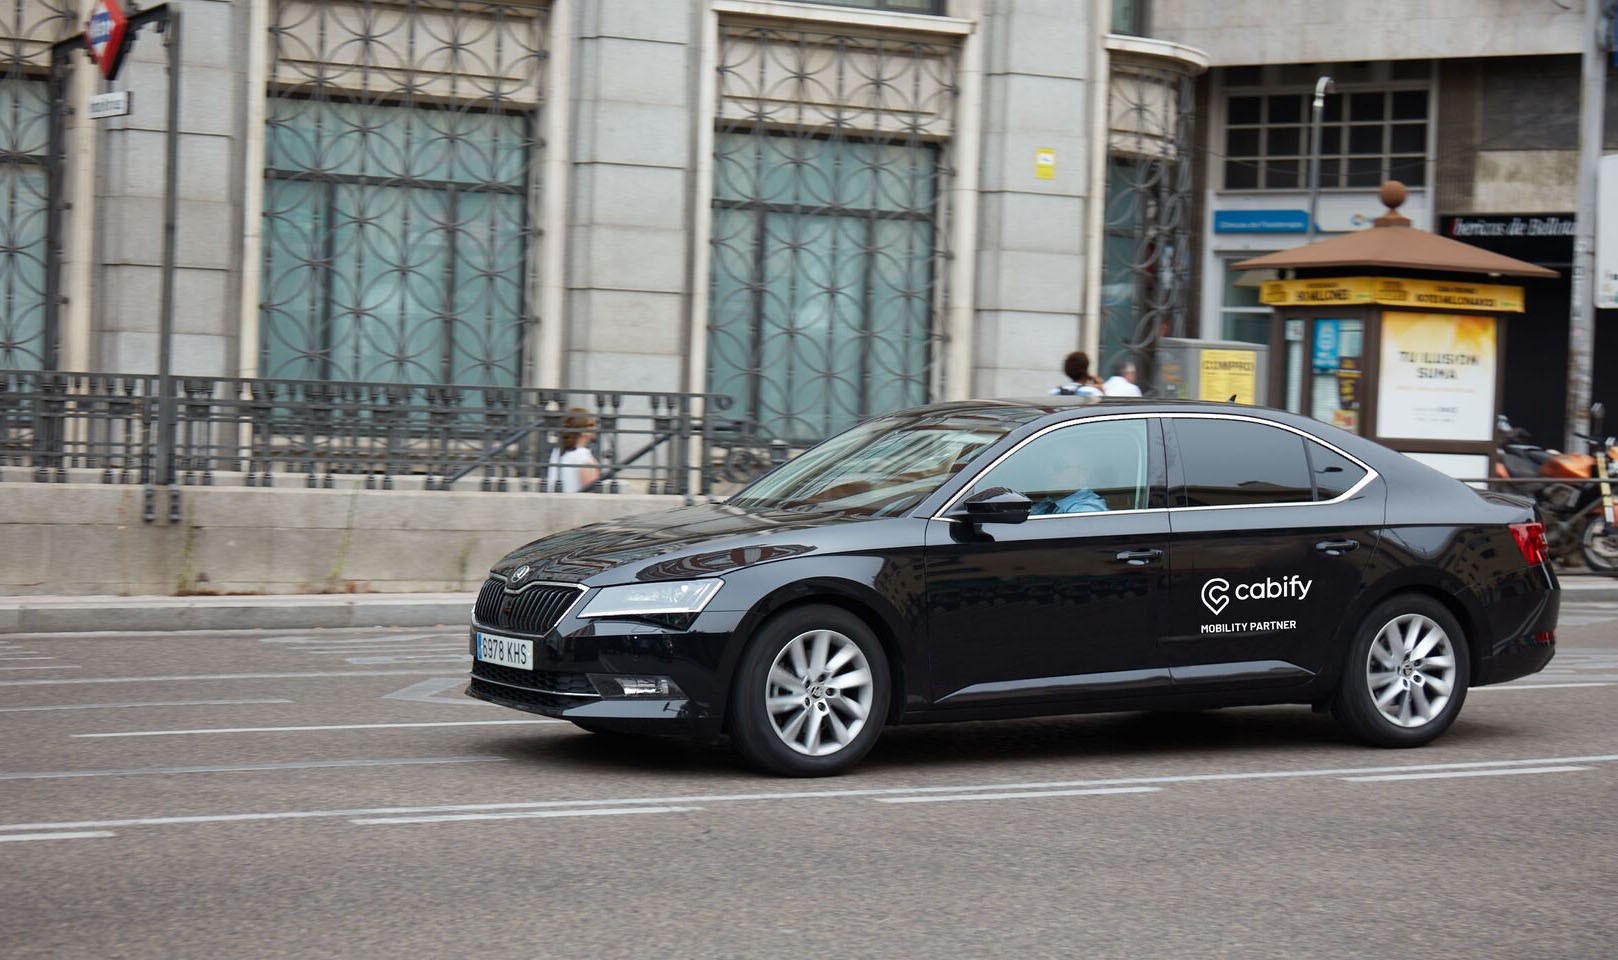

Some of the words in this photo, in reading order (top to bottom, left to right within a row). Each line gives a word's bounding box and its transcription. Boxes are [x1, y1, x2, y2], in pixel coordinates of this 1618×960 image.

[1235, 574, 1313, 600] cabify
[1200, 622, 1248, 633] MOBILITY
[1249, 620, 1297, 631] PARTNER
[482, 637, 504, 661] 6978
[507, 642, 527, 665] KHS
